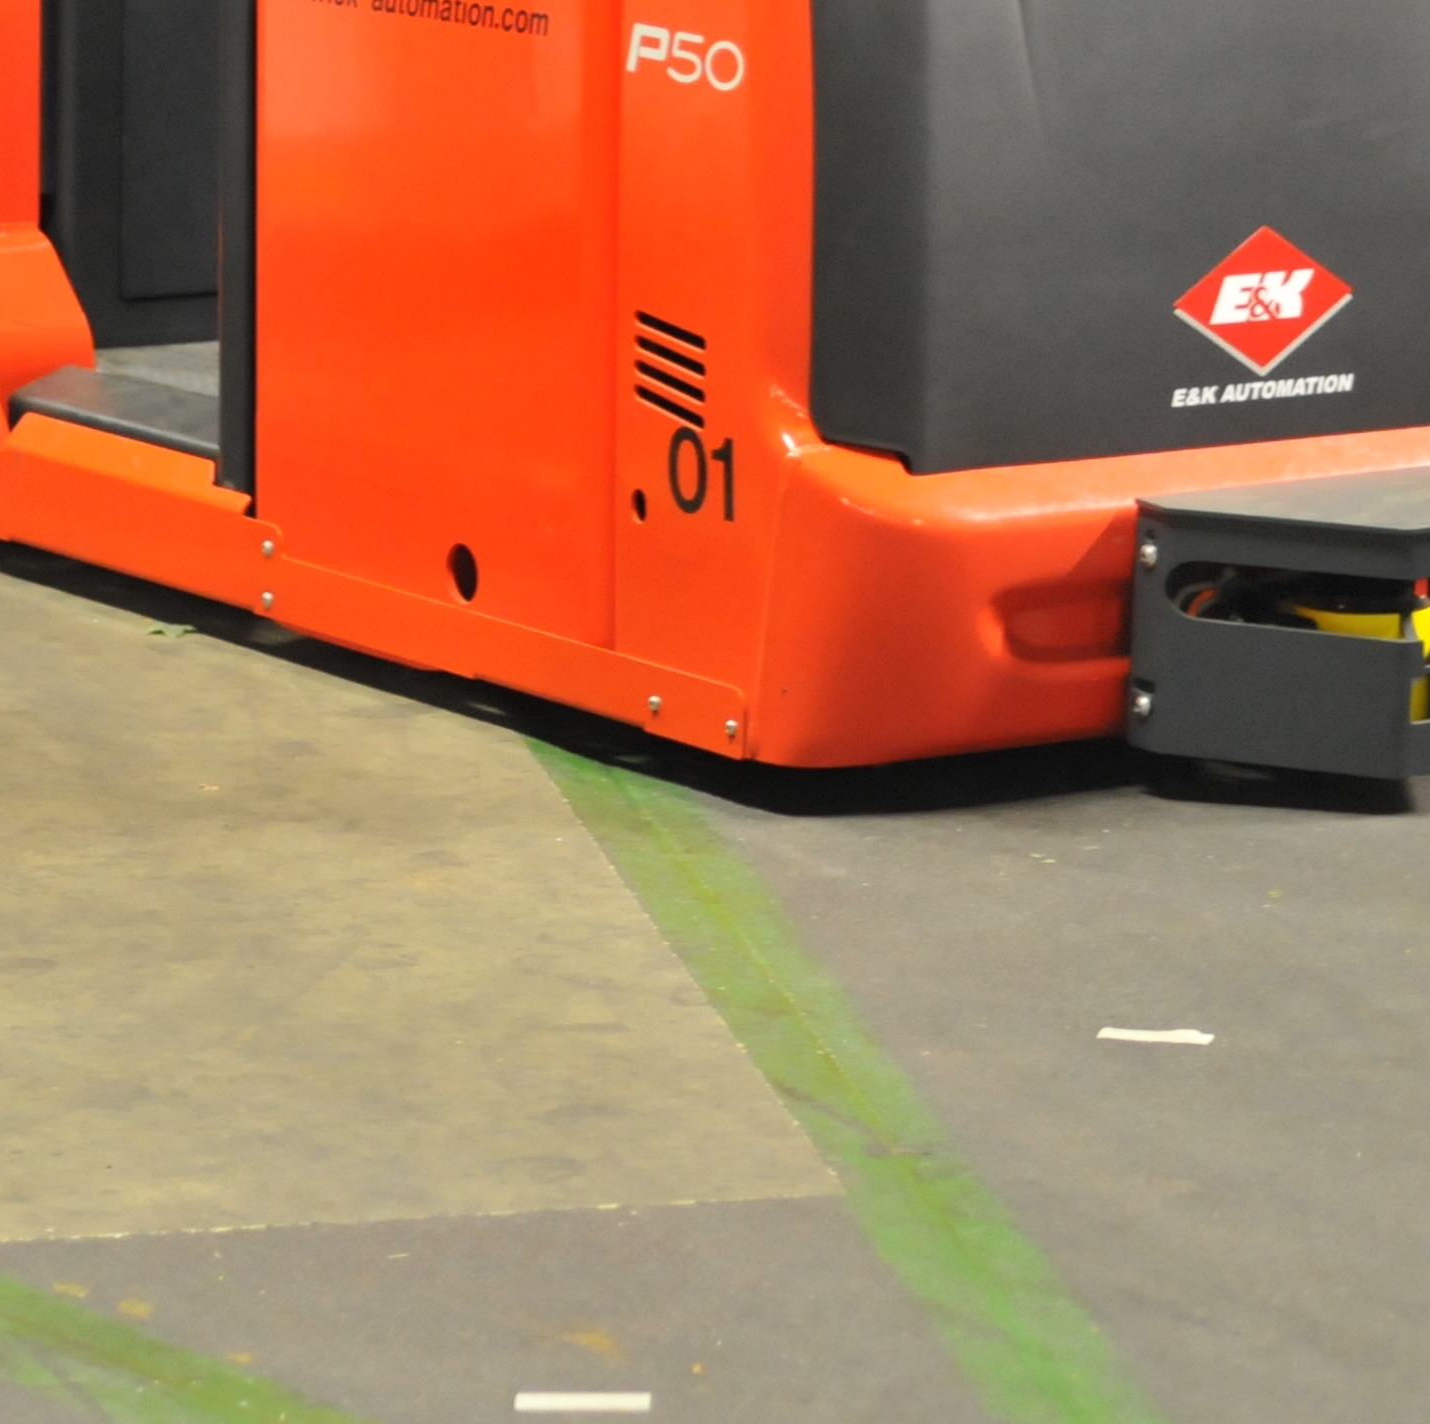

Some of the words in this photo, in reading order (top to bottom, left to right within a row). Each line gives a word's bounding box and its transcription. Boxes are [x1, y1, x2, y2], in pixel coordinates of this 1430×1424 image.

[626, 22, 745, 92] P50
[1208, 268, 1315, 326] E&K
[1170, 385, 1219, 409] E&K
[1220, 373, 1355, 404] AUTOMATION
[668, 425, 735, 523] 01
